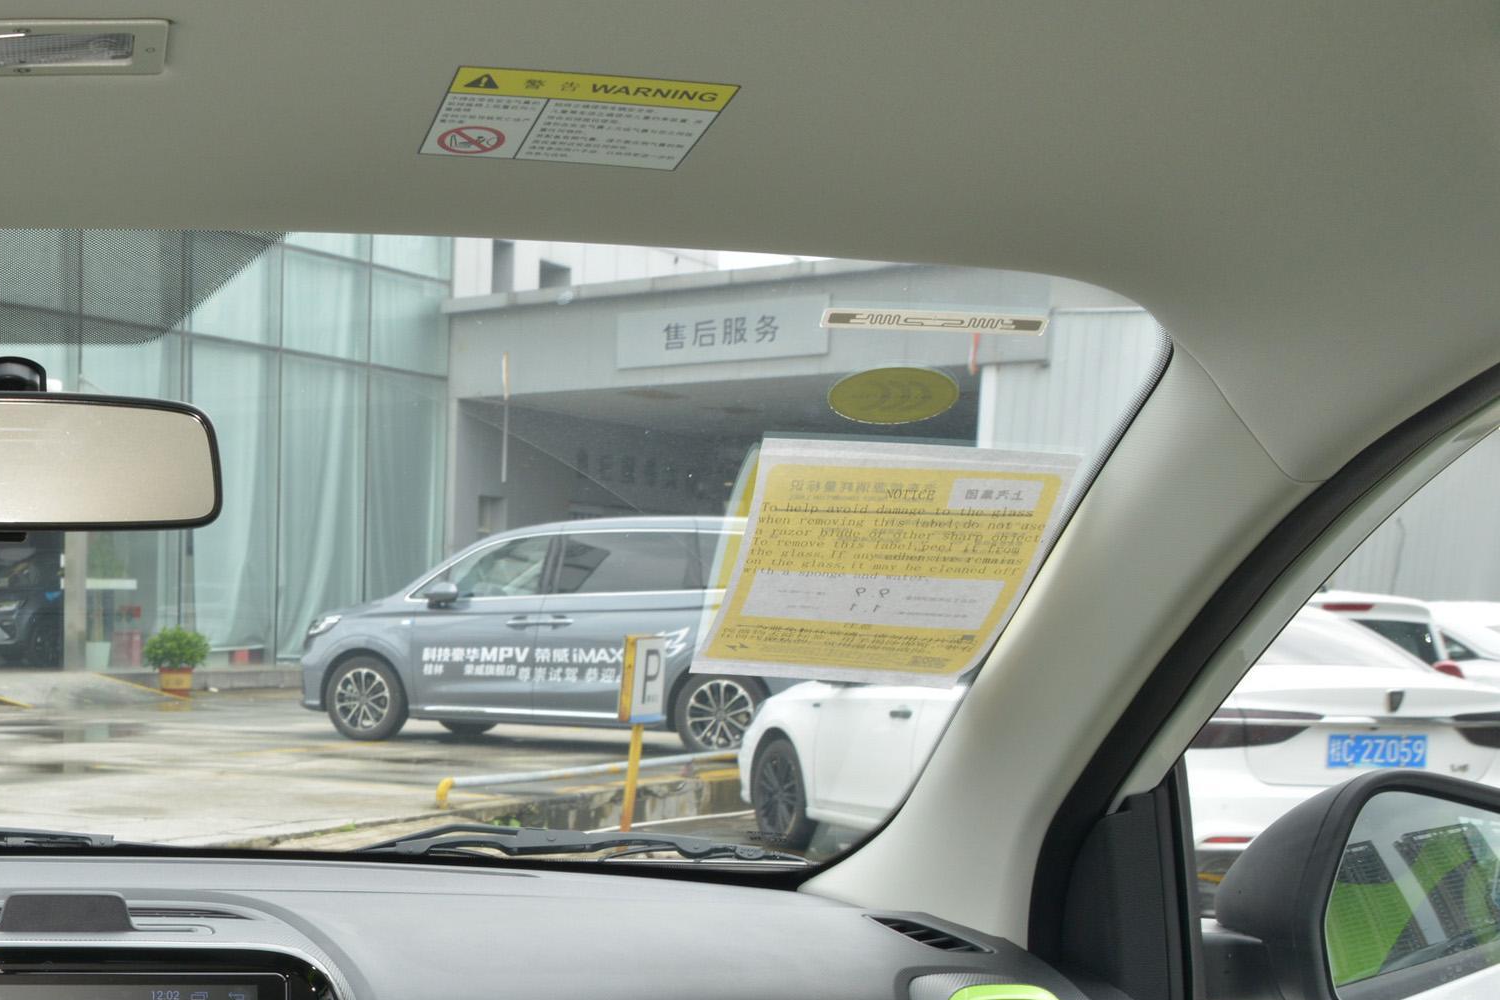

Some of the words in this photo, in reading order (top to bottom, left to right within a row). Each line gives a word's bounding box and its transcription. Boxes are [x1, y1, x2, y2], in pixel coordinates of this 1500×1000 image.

[591, 82, 718, 103] WARNING
[662, 313, 780, 352] 售后服务
[885, 488, 937, 501] NOTICE
[762, 502, 778, 512] To
[786, 502, 818, 515] help
[826, 503, 868, 514] avoid
[876, 504, 926, 516] damage
[935, 507, 950, 516] to
[960, 507, 984, 517] the
[991, 506, 1033, 518] glass
[758, 515, 790, 525] when
[799, 516, 864, 528] removing
[874, 517, 905, 527] this
[987, 519, 1012, 530] not
[1020, 521, 1046, 532] use
[771, 528, 812, 537] razor
[819, 527, 861, 538] blade
[893, 531, 932, 542] other
[943, 531, 983, 544] sharp
[753, 536, 768, 546] To
[776, 539, 825, 548] remove
[833, 539, 864, 549] this
[963, 543, 980, 553] it
[988, 543, 1020, 555] from
[750, 548, 773, 557] the
[830, 550, 846, 560] If
[852, 551, 877, 562] any
[966, 554, 1025, 566] remains
[745, 557, 762, 566] on
[771, 558, 794, 567] the
[851, 560, 864, 570] it
[871, 562, 896, 573] may
[906, 562, 922, 572] be
[929, 563, 987, 575] cleaned
[993, 566, 1020, 576] off
[798, 569, 845, 580] sponge
[852, 571, 878, 580] and
[534, 647, 570, 663] 荣威
[585, 667, 622, 684] 恭迎
[641, 648, 661, 705] P
[150, 990, 180, 1000] 12:02
